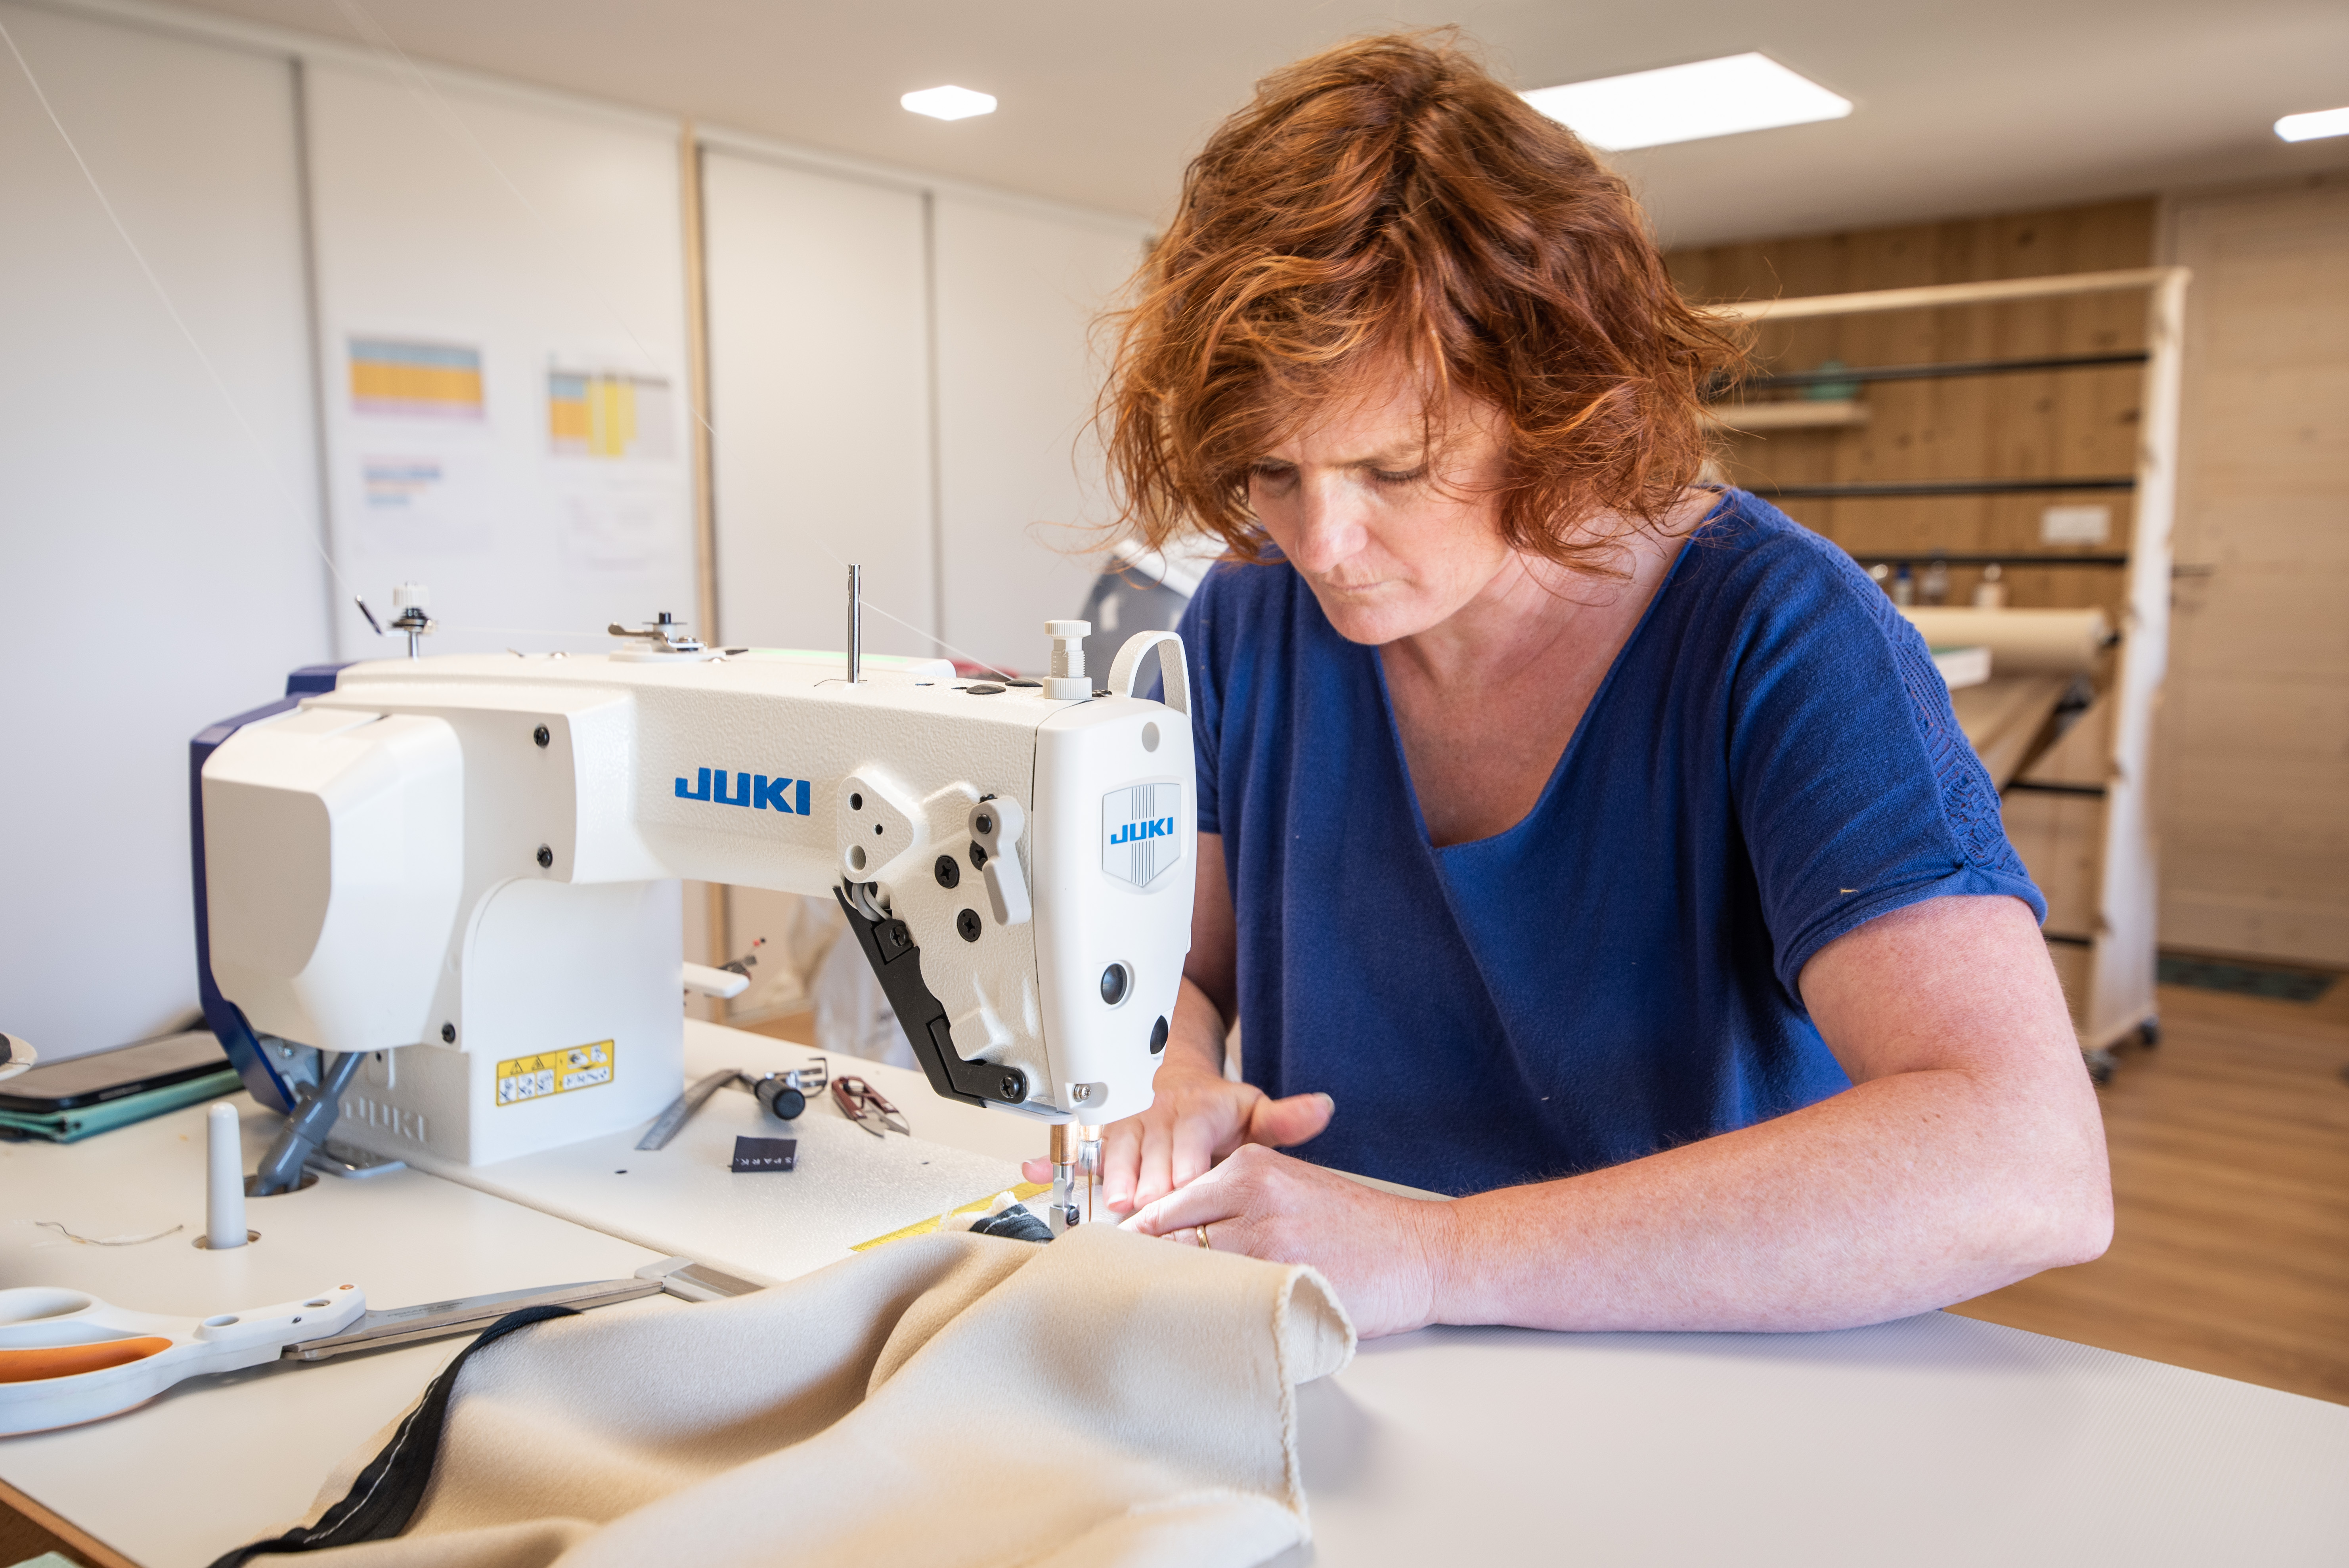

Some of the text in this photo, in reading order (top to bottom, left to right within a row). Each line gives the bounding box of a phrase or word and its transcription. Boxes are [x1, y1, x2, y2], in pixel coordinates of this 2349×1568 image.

[675, 767, 811, 816] JUKI
[1111, 817, 1173, 845] JUKI
[345, 1096, 429, 1142] JUKI
